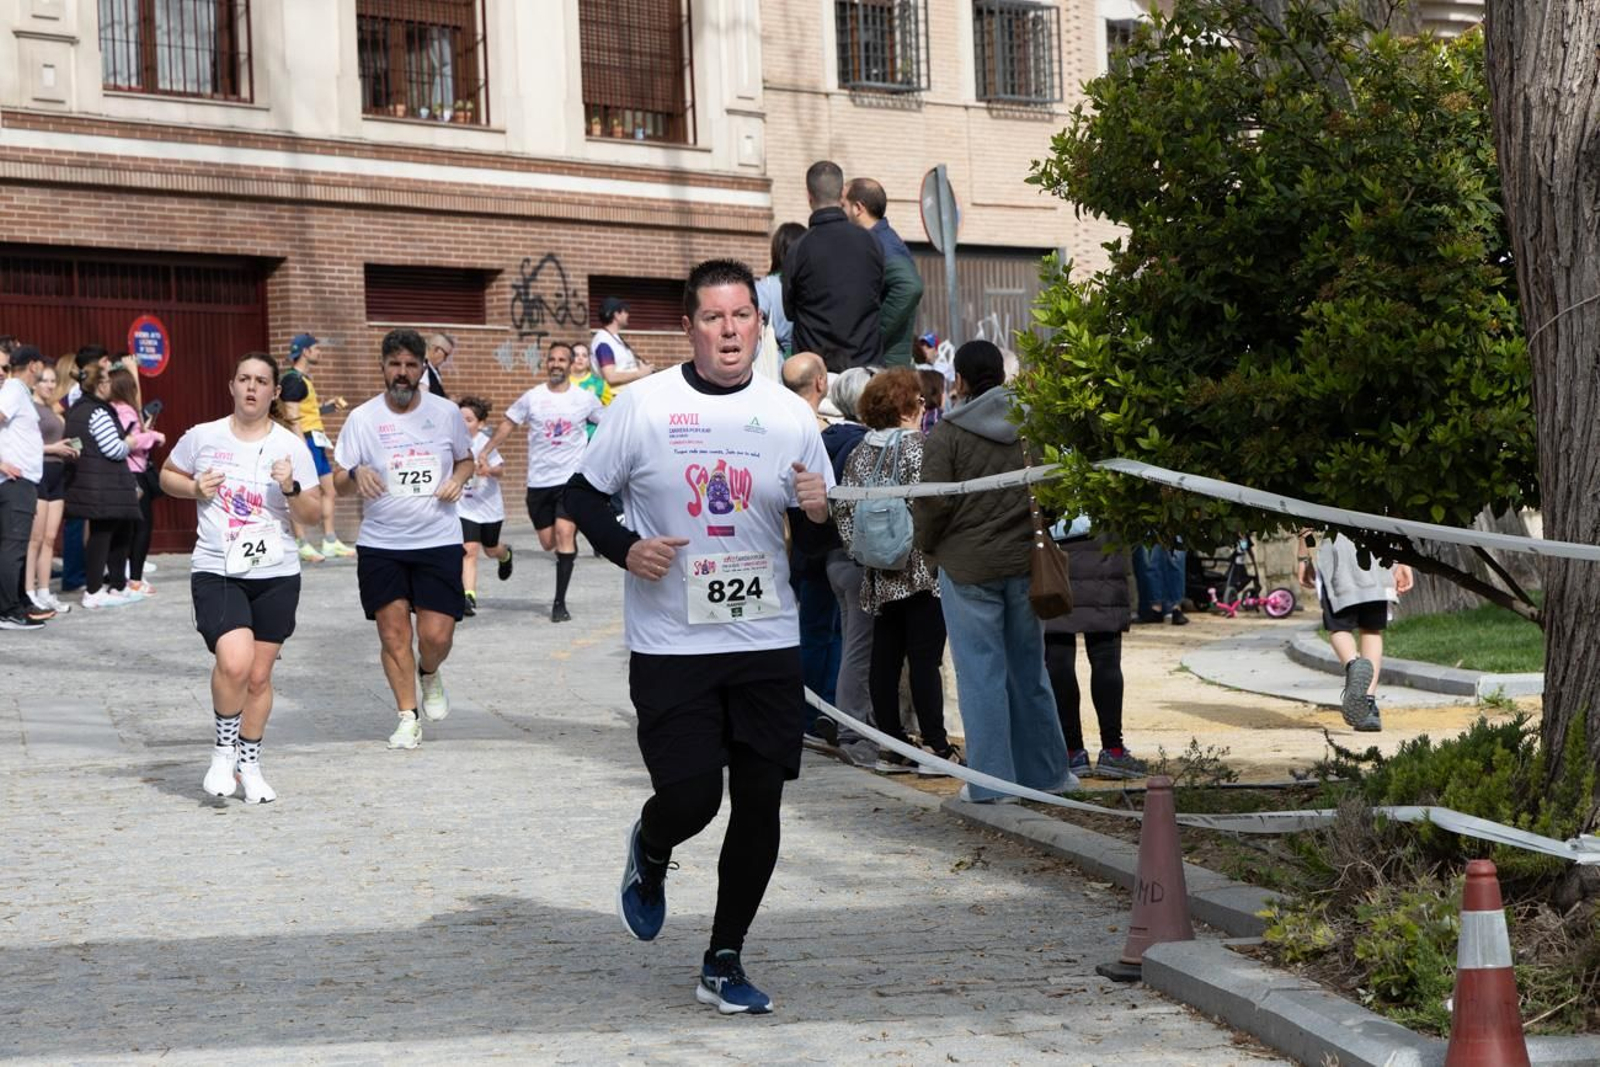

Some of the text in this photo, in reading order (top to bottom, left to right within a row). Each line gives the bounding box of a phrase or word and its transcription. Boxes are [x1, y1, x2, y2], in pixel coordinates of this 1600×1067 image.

[669, 413, 699, 425] XXVII
[398, 470, 432, 485] 725
[242, 539, 267, 558] 24
[707, 576, 763, 604] 824
